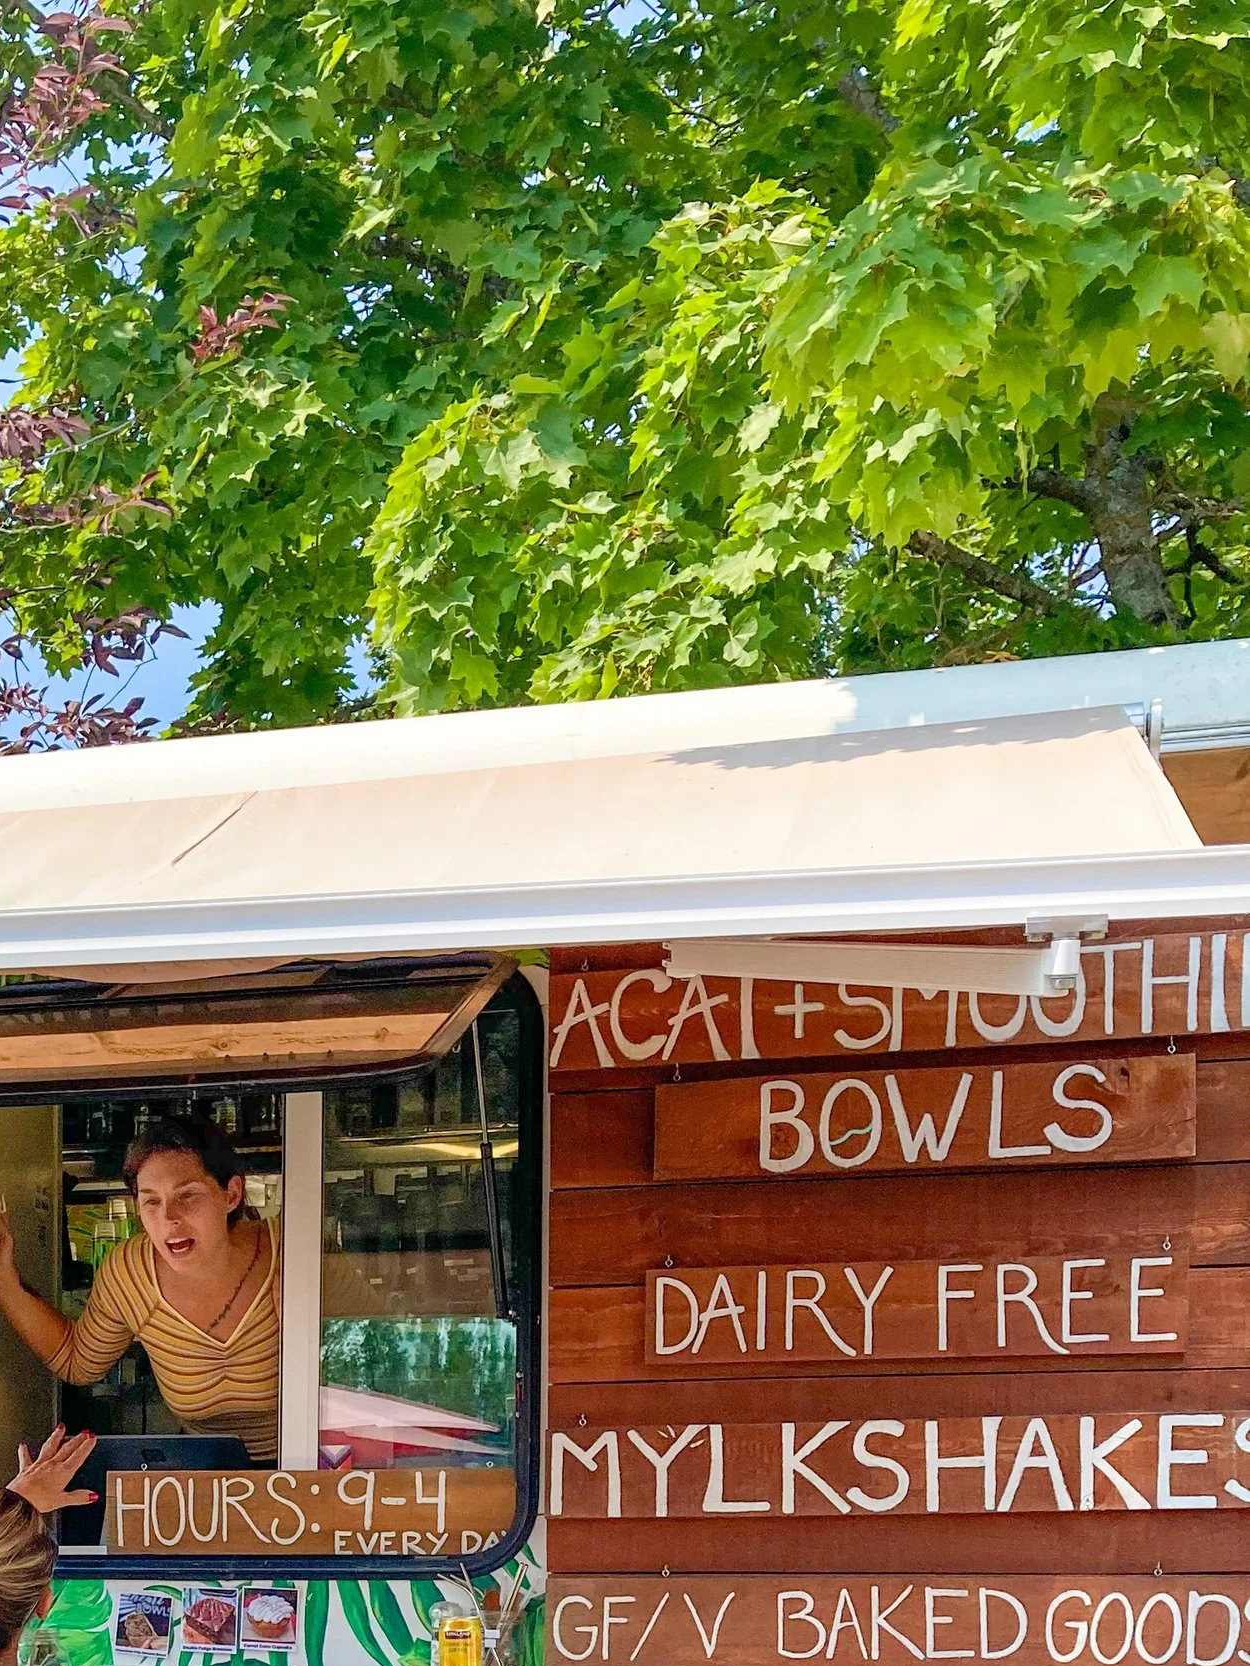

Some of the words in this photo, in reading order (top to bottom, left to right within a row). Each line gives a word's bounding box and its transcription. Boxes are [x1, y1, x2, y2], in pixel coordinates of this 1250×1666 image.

[550, 934, 1250, 1068] ACAI+SMOOTHI
[759, 1065, 1113, 1173] BOWLS
[654, 1265, 894, 1357] DAIRY
[936, 1257, 1179, 1355] FREE
[115, 1471, 320, 1547] HOURS:
[337, 1470, 447, 1534] 9-4
[334, 1531, 449, 1556] EVERY
[460, 1530, 507, 1555] DA
[777, 1584, 1028, 1660] BAKED
